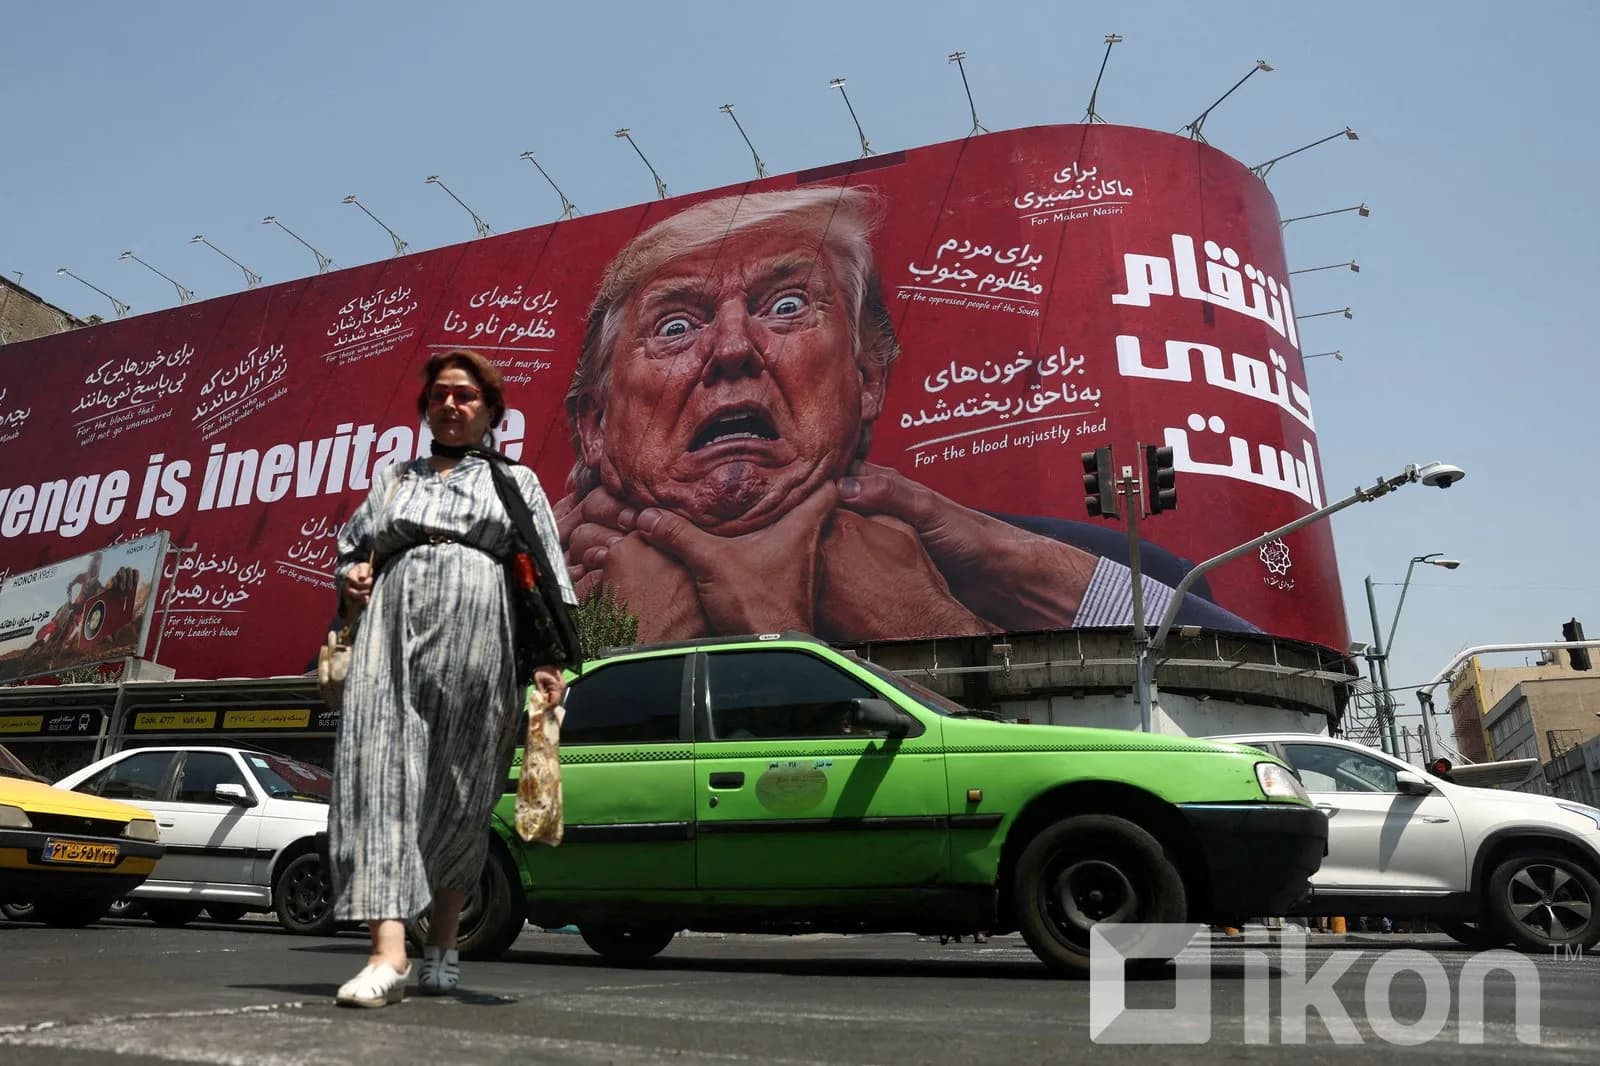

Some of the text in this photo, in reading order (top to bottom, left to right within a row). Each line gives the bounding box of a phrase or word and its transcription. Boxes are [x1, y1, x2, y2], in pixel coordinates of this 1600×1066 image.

[1053, 161, 1098, 183] برای
[1014, 179, 1133, 209] ماکان نصیری
[1031, 206, 1123, 226] For Makan Nasiri
[936, 238, 1043, 271] برای مردم
[908, 262, 1043, 294] مظلوم جنوب
[1112, 233, 1299, 350] انتقام
[338, 286, 412, 315] برای آنها که
[469, 285, 559, 315] برای شهدای
[897, 291, 1040, 317] For the oppressed people of the South
[327, 309, 376, 336] کارشان
[333, 317, 402, 347] شهید شدند
[443, 310, 556, 344] مظلوم ناو دنا
[166, 343, 195, 367] برای
[200, 343, 284, 395] برای آنان که
[515, 358, 552, 373] martyrs
[1037, 346, 1085, 376] برای
[85, 359, 114, 384] که
[502, 373, 532, 386] arship
[1115, 335, 1316, 433] حتمی
[191, 358, 288, 421] زیر آوار ماندند
[77, 405, 155, 438] For the bloods that
[81, 408, 173, 446] will not go unanswered
[202, 398, 258, 433] For those who
[914, 417, 1107, 468] For the blood unjustly shed
[1164, 412, 1323, 511] است
[135, 453, 192, 520] is
[301, 515, 347, 540] ادران
[287, 540, 328, 565] ایران
[13, 572, 38, 588] HONOR
[238, 560, 266, 584] برای
[212, 584, 250, 609] خون
[164, 626, 240, 640] of my Leader's blood
[168, 615, 222, 627] For the justice
